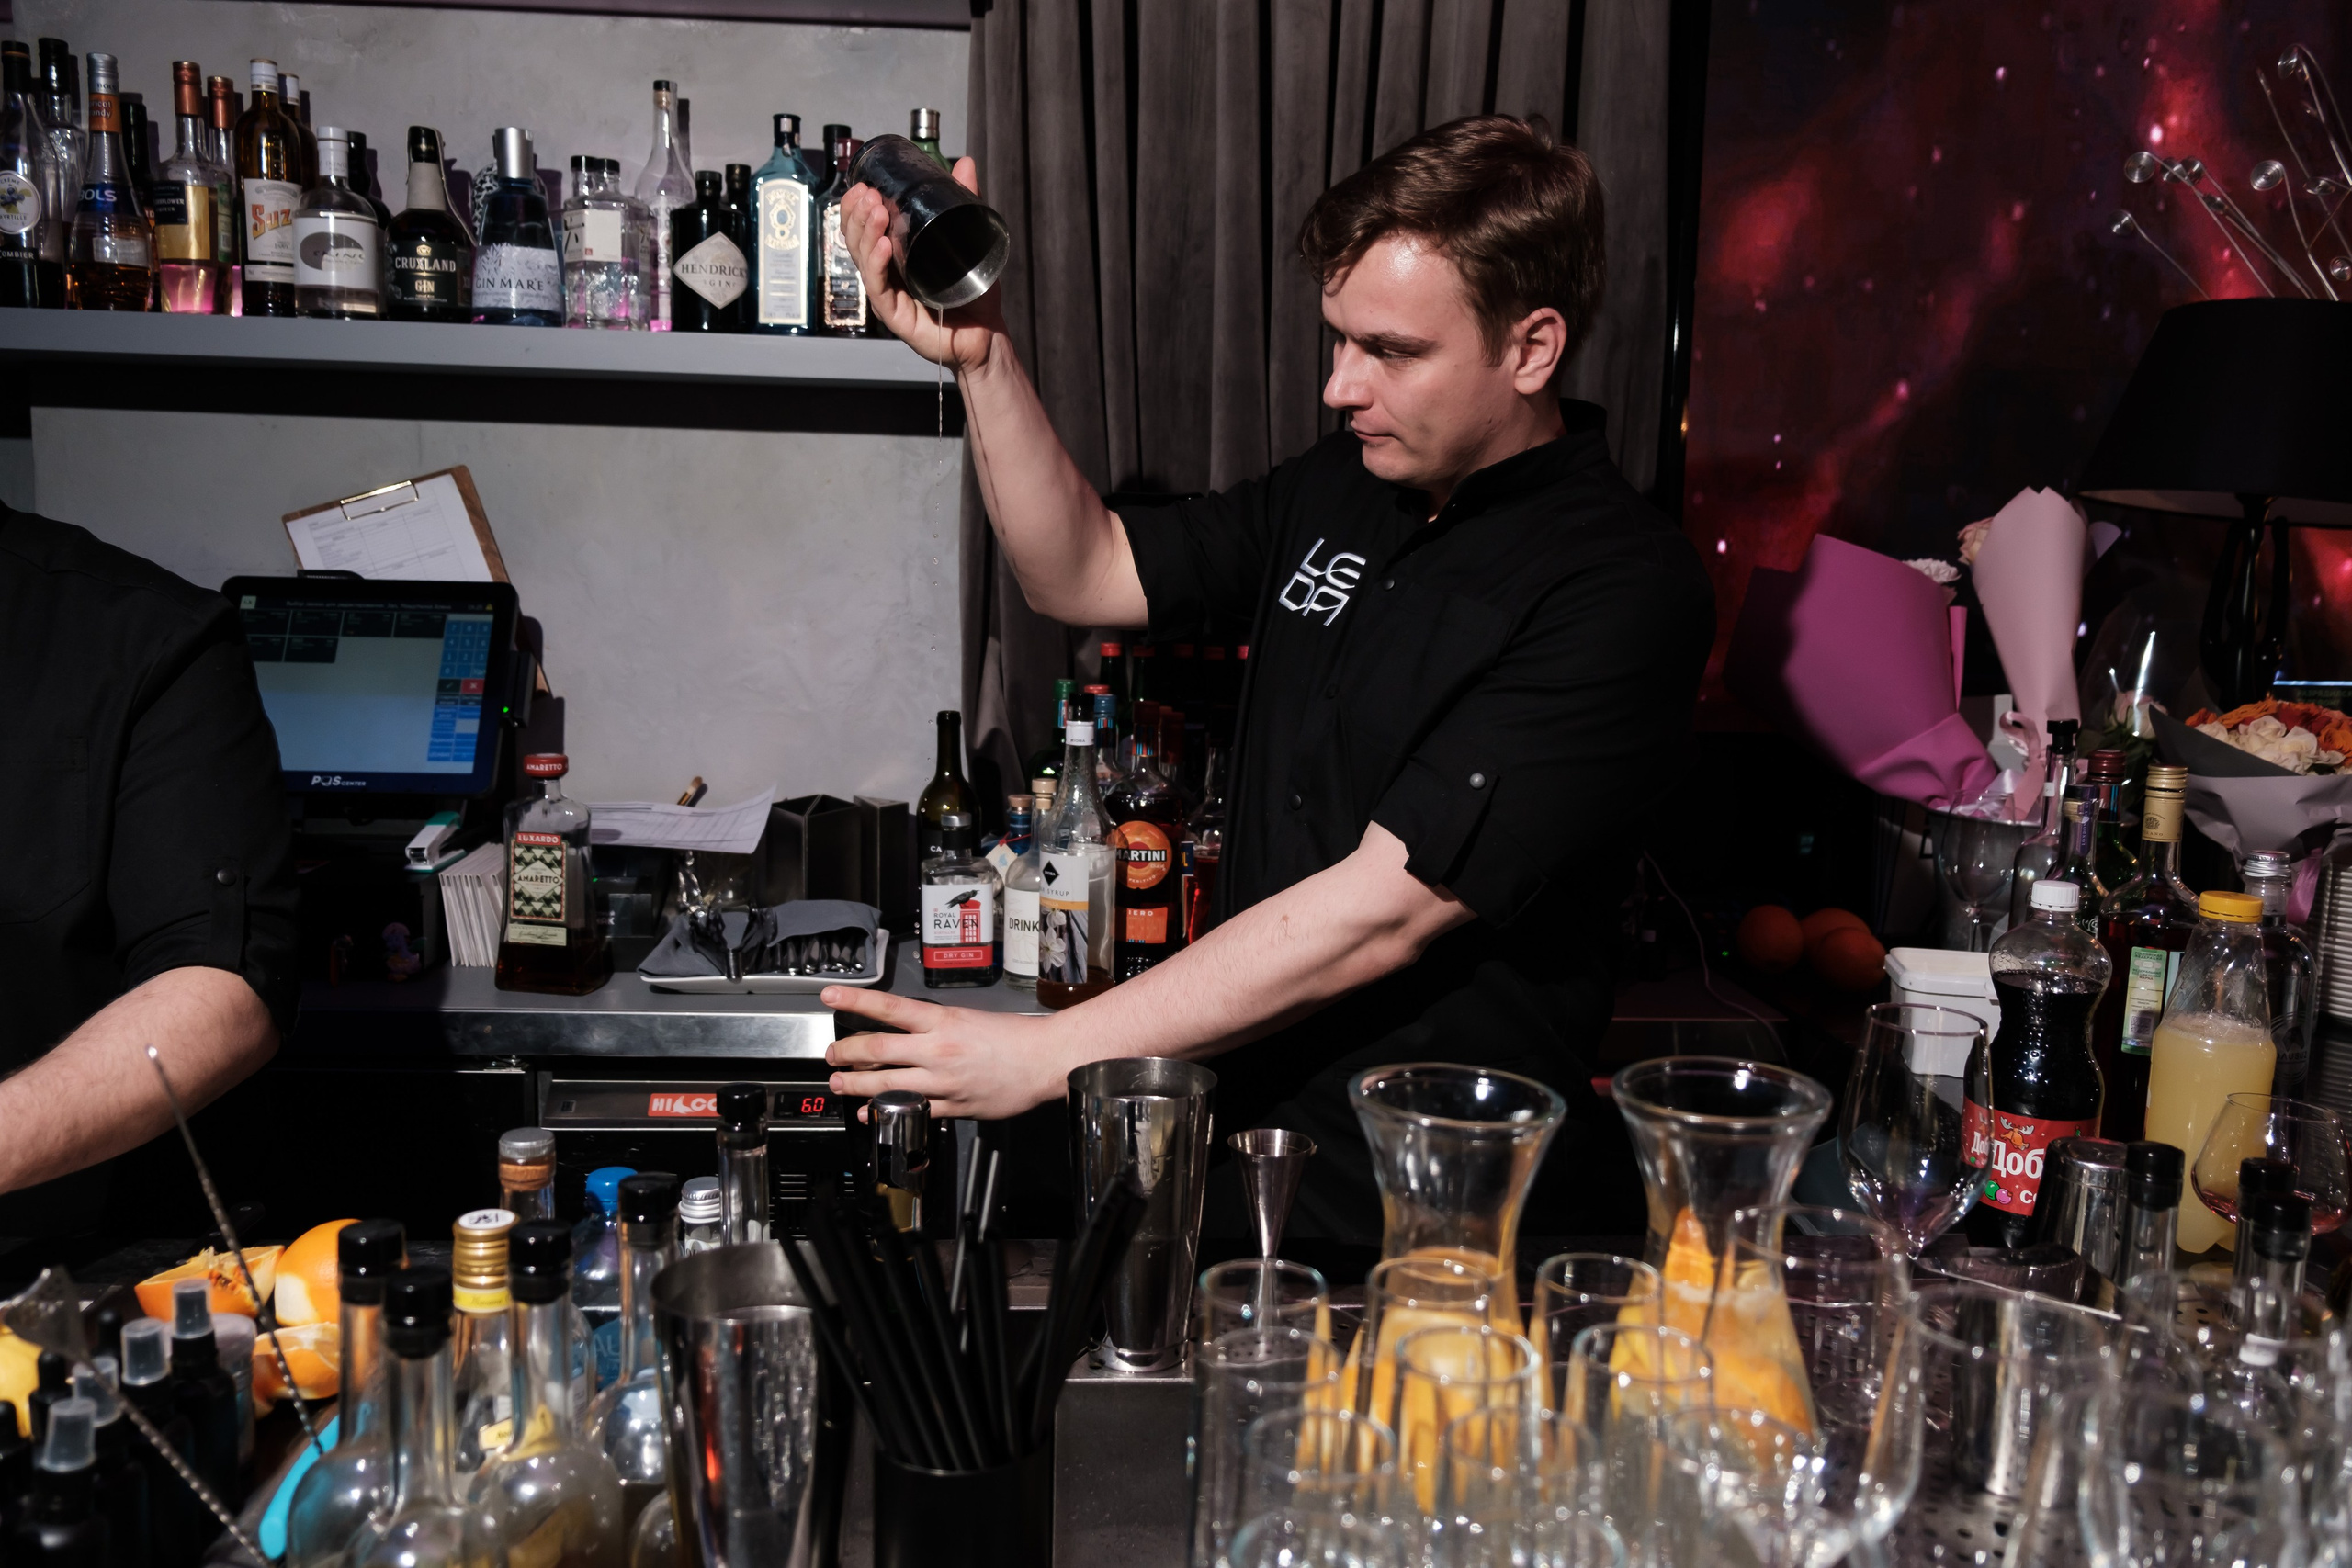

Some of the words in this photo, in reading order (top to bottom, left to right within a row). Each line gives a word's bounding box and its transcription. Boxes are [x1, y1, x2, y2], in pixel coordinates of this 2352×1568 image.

[395, 256, 457, 273] CRUXLAND
[415, 279, 435, 293] GIN
[475, 277, 495, 288] GIN
[499, 277, 544, 291] MARE
[709, 279, 731, 288] GIN
[526, 761, 563, 773] AMARETTO
[518, 833, 560, 844] LUXARDO
[1116, 850, 1167, 862] MARTINI
[517, 874, 560, 884] AMARETTO
[1046, 887, 1070, 897] SYRUP
[933, 919, 979, 930] RAVEN
[1009, 917, 1040, 932] DRINK
[801, 1097, 825, 1113] 6.0
[1991, 1139, 2045, 1179] Доб
